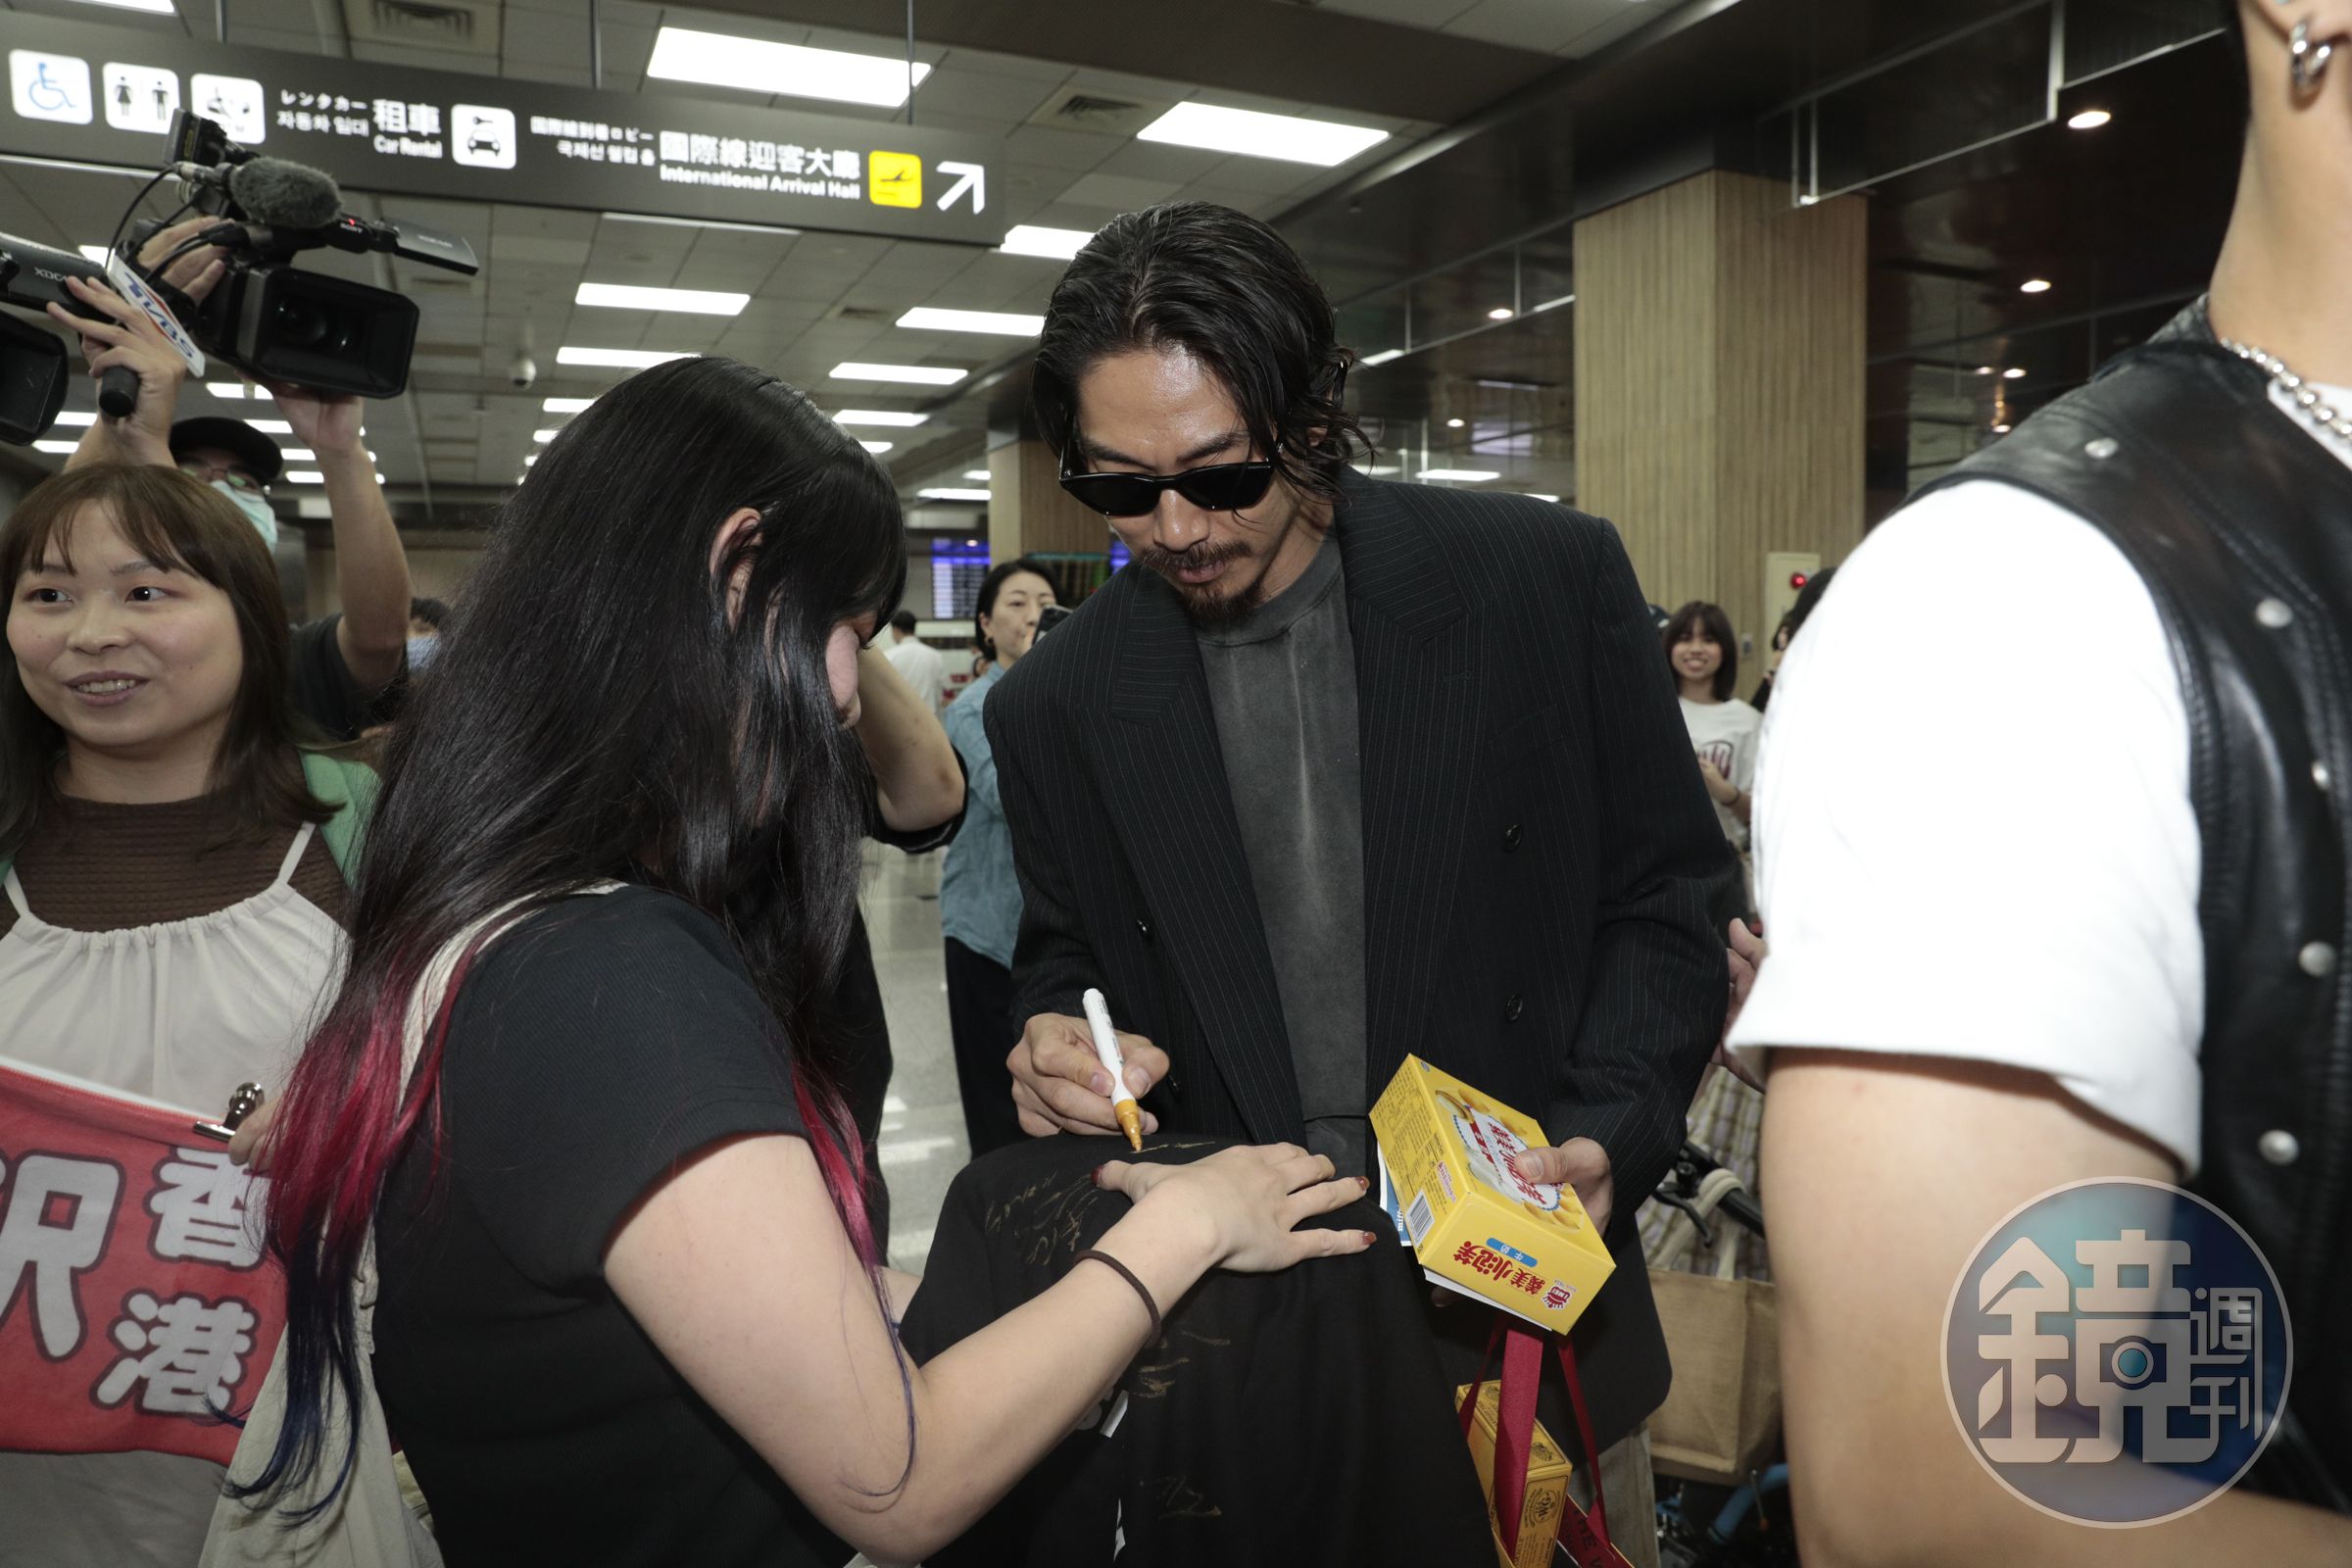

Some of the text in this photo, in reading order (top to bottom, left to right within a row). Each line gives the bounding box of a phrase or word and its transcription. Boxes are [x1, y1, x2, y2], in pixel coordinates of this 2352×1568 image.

[280, 89, 368, 112] レンタカー
[372, 99, 441, 136] 租車
[373, 134, 443, 159] Car Rental
[660, 130, 860, 180] 國際線迎客大廳
[660, 163, 860, 200] International Arrival Hall
[33, 266, 69, 283] XDC
[1499, 1244, 1525, 1261] 牛奶
[1453, 1241, 1546, 1296] 義美小泡芙
